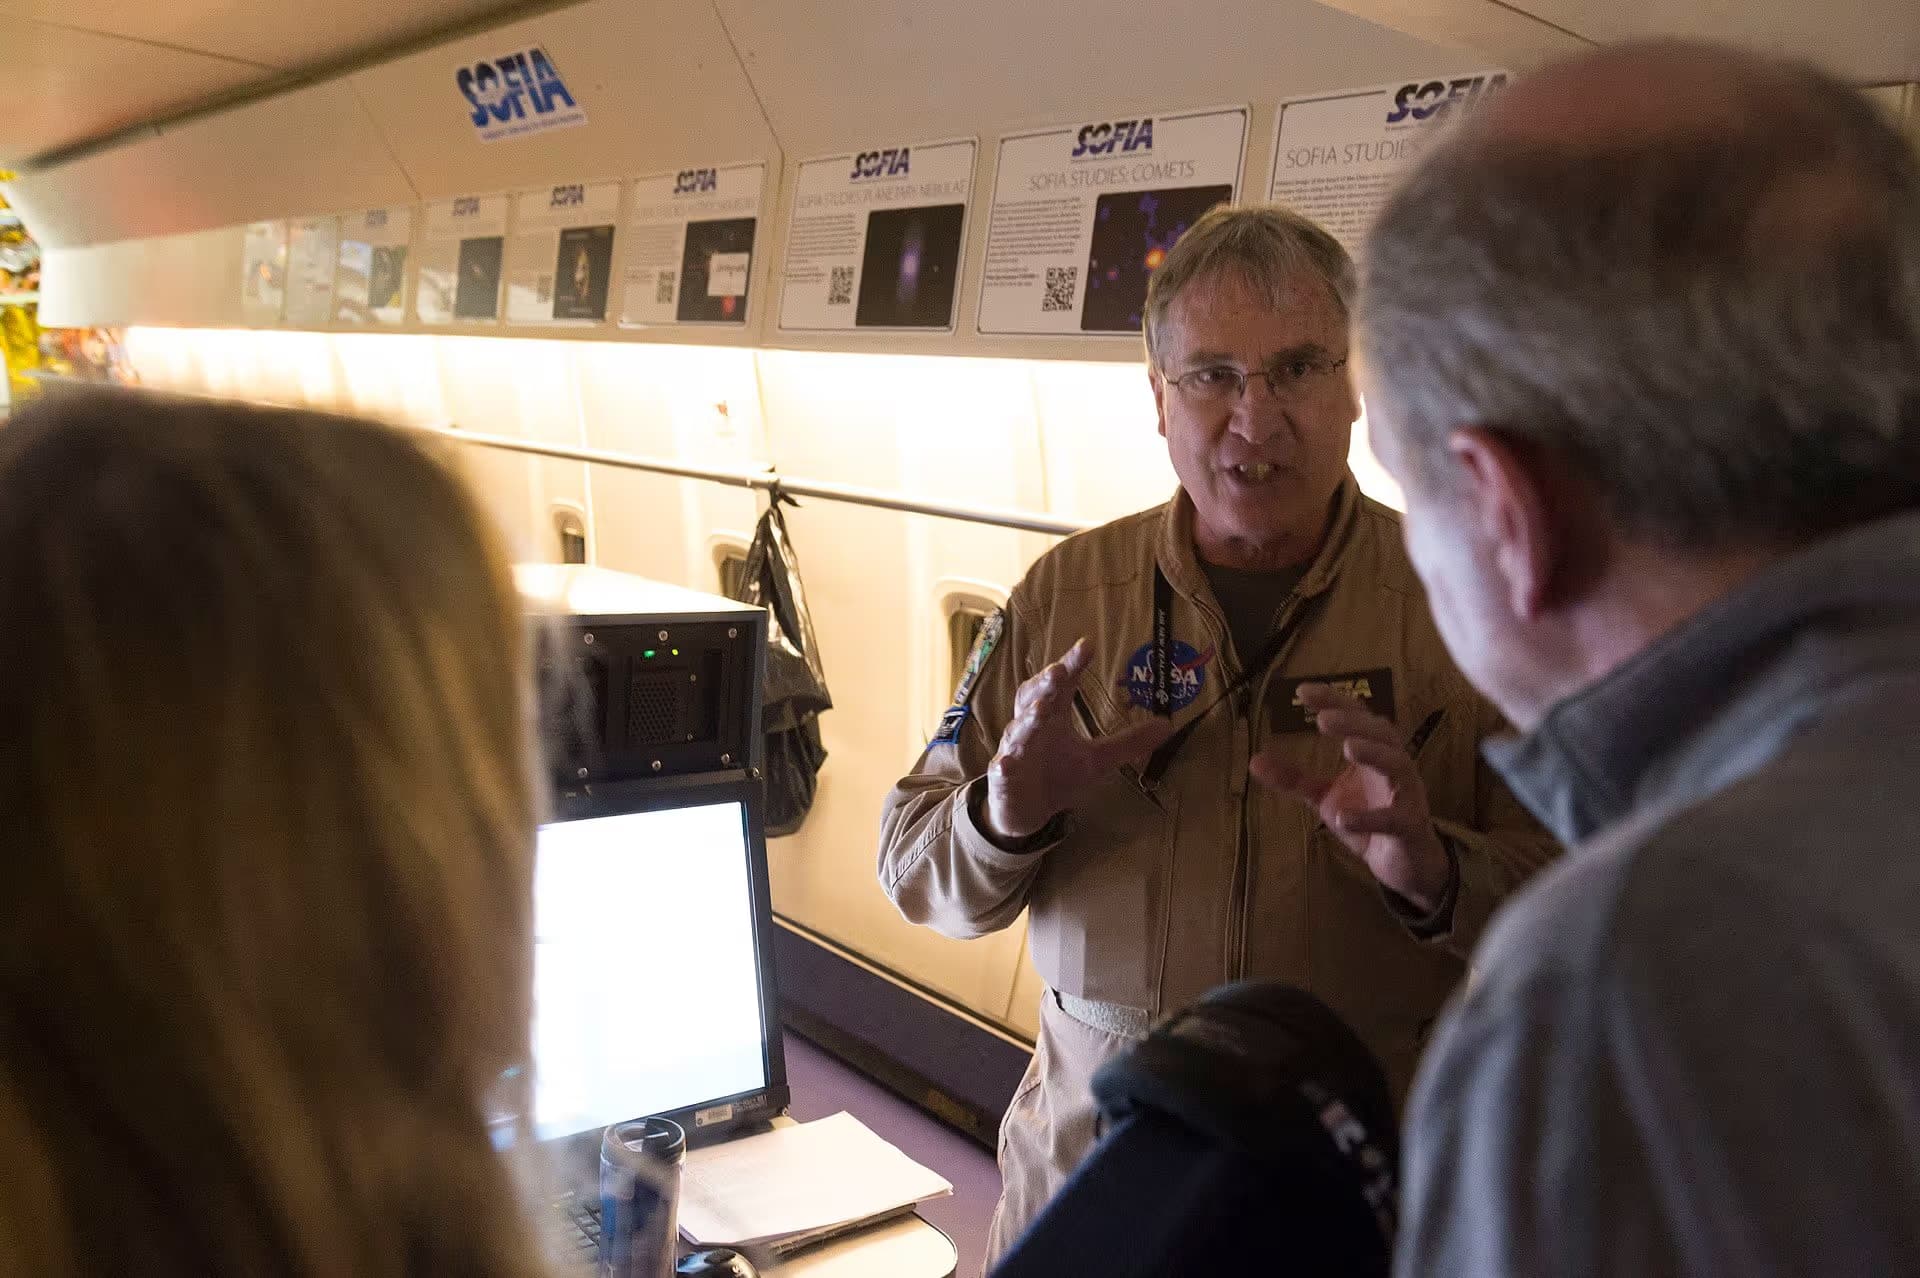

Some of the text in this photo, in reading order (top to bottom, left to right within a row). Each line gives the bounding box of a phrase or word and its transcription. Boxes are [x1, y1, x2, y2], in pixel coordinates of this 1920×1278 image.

[457, 48, 576, 128] SOFIA
[1072, 118, 1153, 157] SOFIA
[851, 147, 910, 179] SOFIA
[1285, 145, 1338, 169] SOFIA
[1029, 172, 1067, 191] SOFIA
[1132, 159, 1196, 183] COMETS
[1131, 664, 1199, 686] NSA
